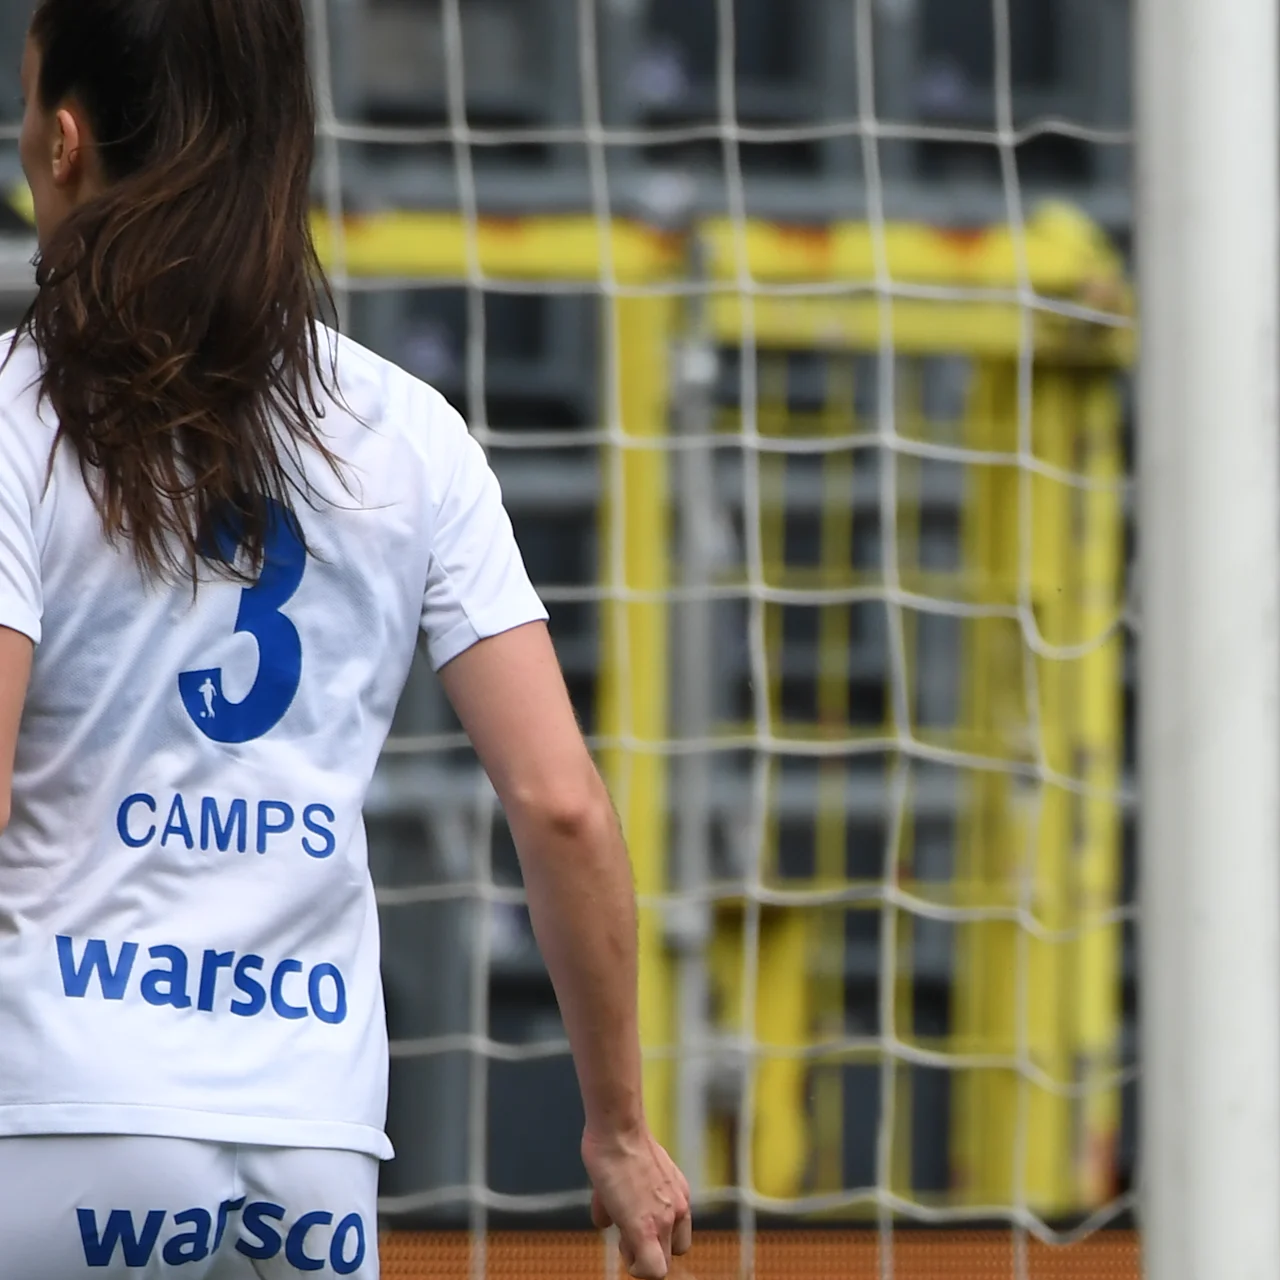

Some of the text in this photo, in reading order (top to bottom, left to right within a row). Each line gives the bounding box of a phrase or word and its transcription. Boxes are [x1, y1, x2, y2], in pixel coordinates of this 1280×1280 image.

[178, 494, 306, 743] 3
[117, 793, 337, 859] CAMPS
[55, 934, 349, 1024] warsco
[76, 1195, 366, 1275] warsco
